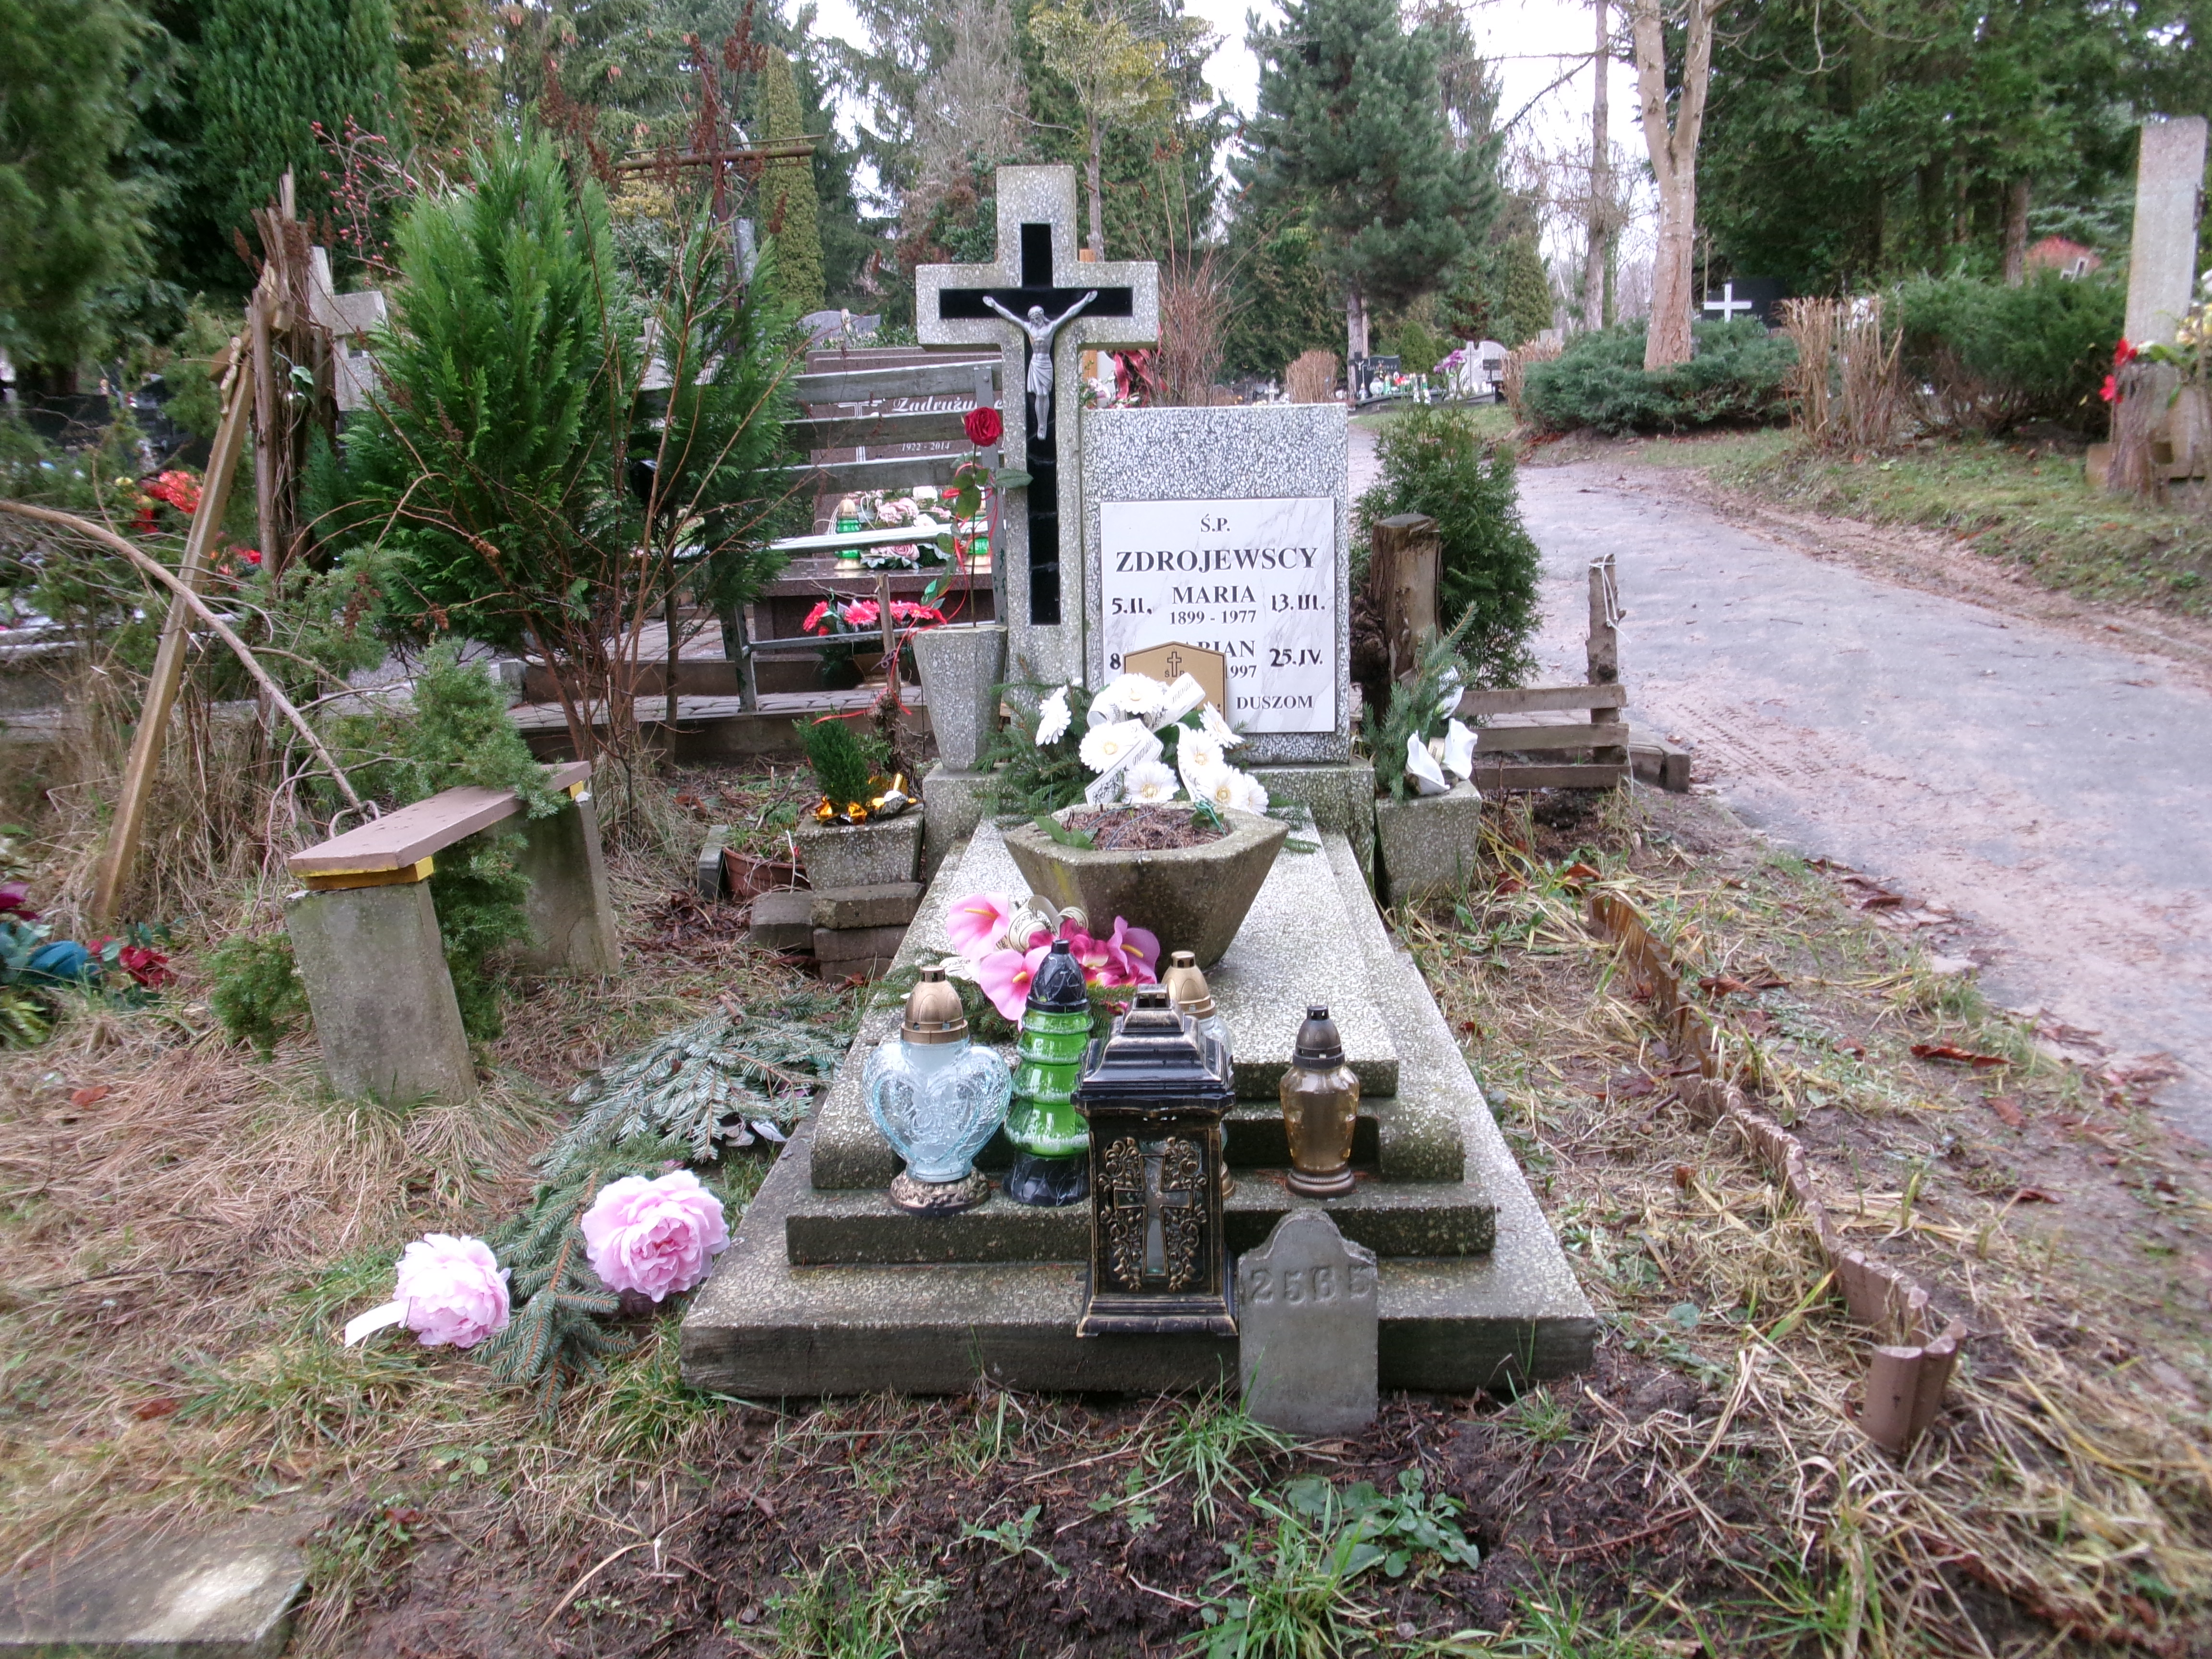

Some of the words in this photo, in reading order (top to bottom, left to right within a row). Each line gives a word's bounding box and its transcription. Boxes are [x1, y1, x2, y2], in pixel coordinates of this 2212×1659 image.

[930, 441, 950, 451] 2014
[1201, 514, 1230, 532] Ś.P.
[1116, 547, 1318, 573] ZDROJEWSCY
[1172, 585, 1256, 604] MARIA
[1170, 611, 1205, 625] 1899
[1221, 610, 1256, 623] 1977
[1109, 653, 1121, 670] 8
[1269, 648, 1323, 667] 25.IV.
[1237, 696, 1313, 709] DUSZOM
[1250, 1266, 1372, 1304] 2565
